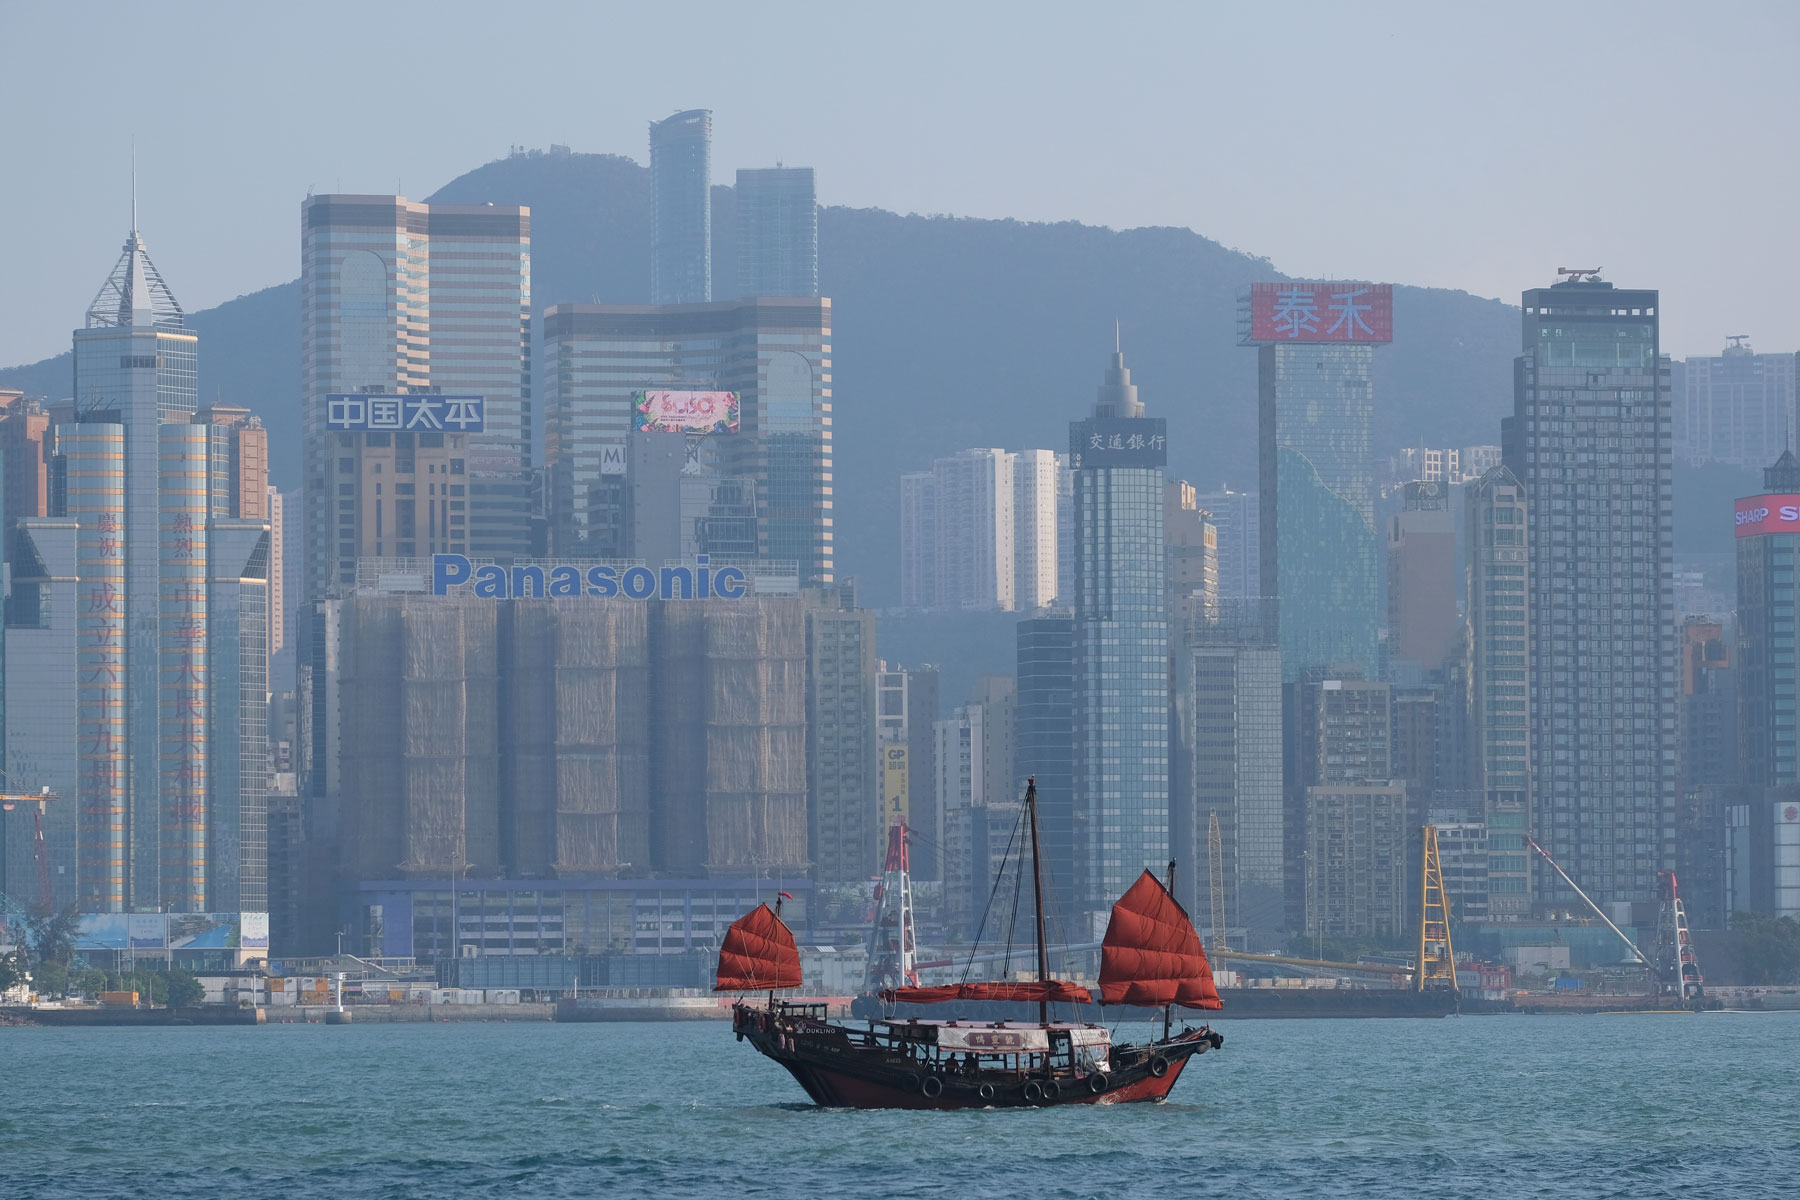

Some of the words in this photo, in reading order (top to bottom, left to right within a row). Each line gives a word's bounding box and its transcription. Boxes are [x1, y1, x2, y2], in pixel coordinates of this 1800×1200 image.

[1271, 287, 1376, 339] 泰禾
[328, 397, 481, 429] 中国太平
[1089, 433, 1166, 450] 交通銀行
[1735, 507, 1769, 525] SHARP
[432, 553, 748, 600] Panasonic
[888, 749, 905, 760] GP
